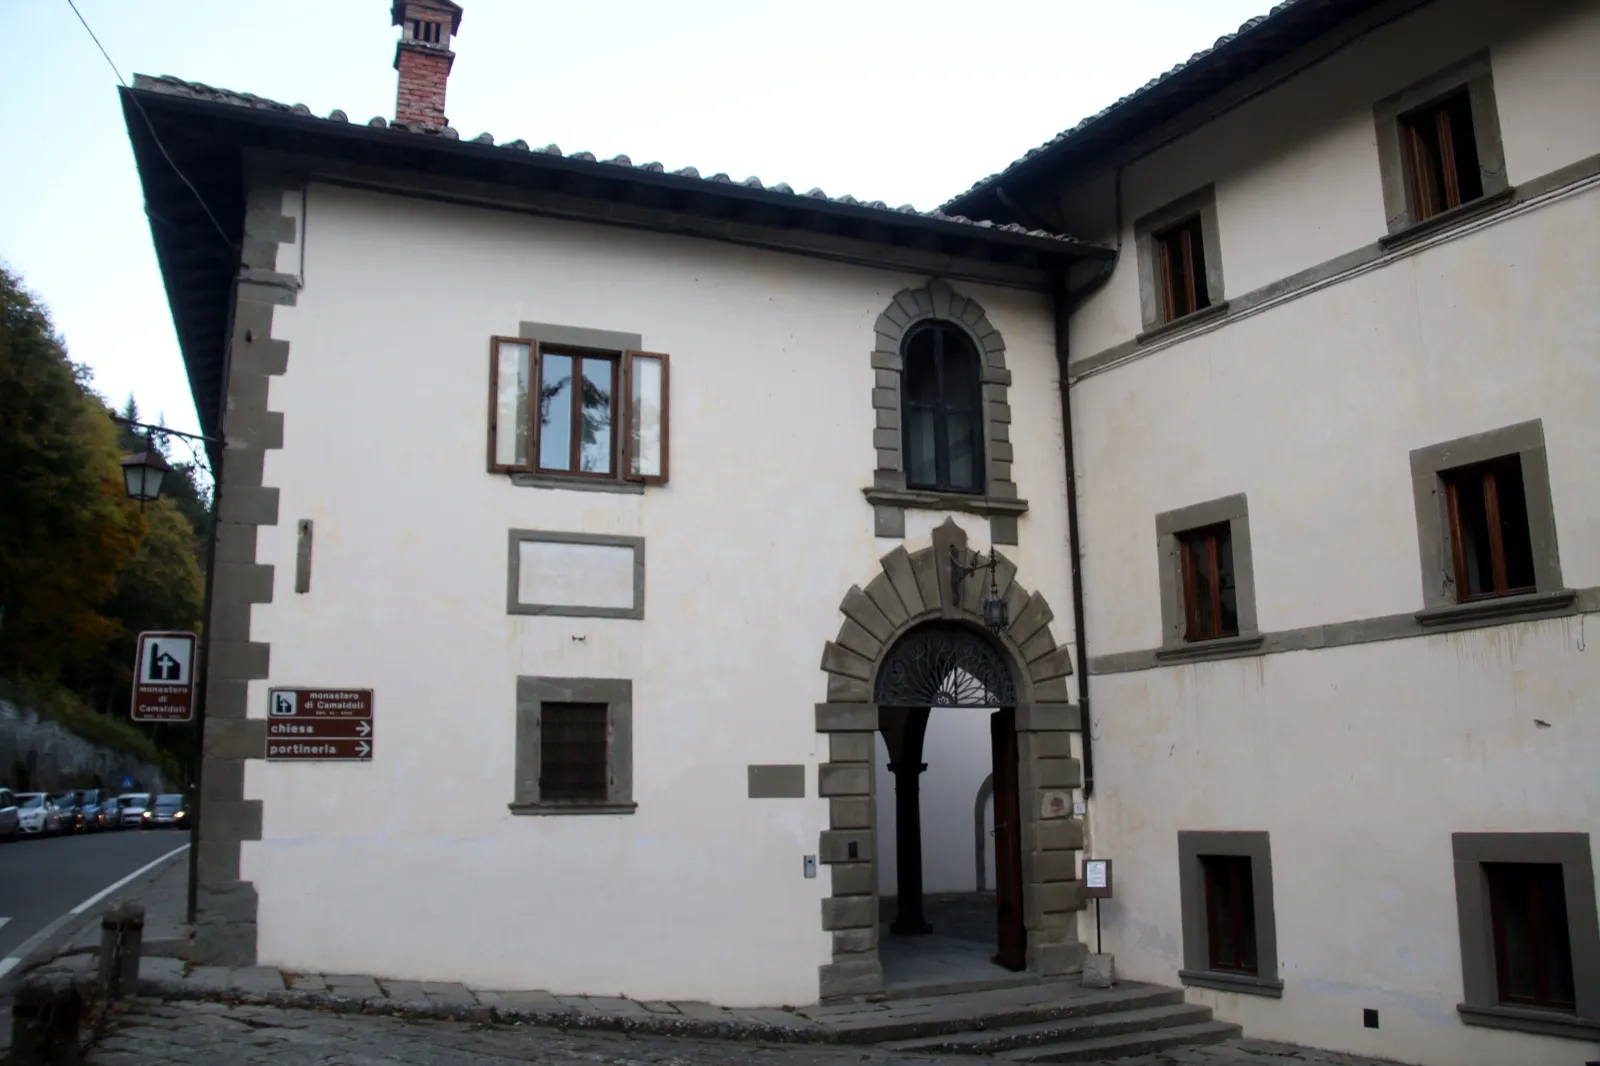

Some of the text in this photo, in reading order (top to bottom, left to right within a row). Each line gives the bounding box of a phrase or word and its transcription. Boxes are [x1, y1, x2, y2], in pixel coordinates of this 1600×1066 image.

[158, 695, 168, 703] di
[309, 692, 360, 700] monastero
[139, 704, 187, 713] Camaldoli
[304, 700, 365, 709] di Camaldoli
[270, 723, 314, 734] chiesa
[269, 743, 337, 755] portineria
